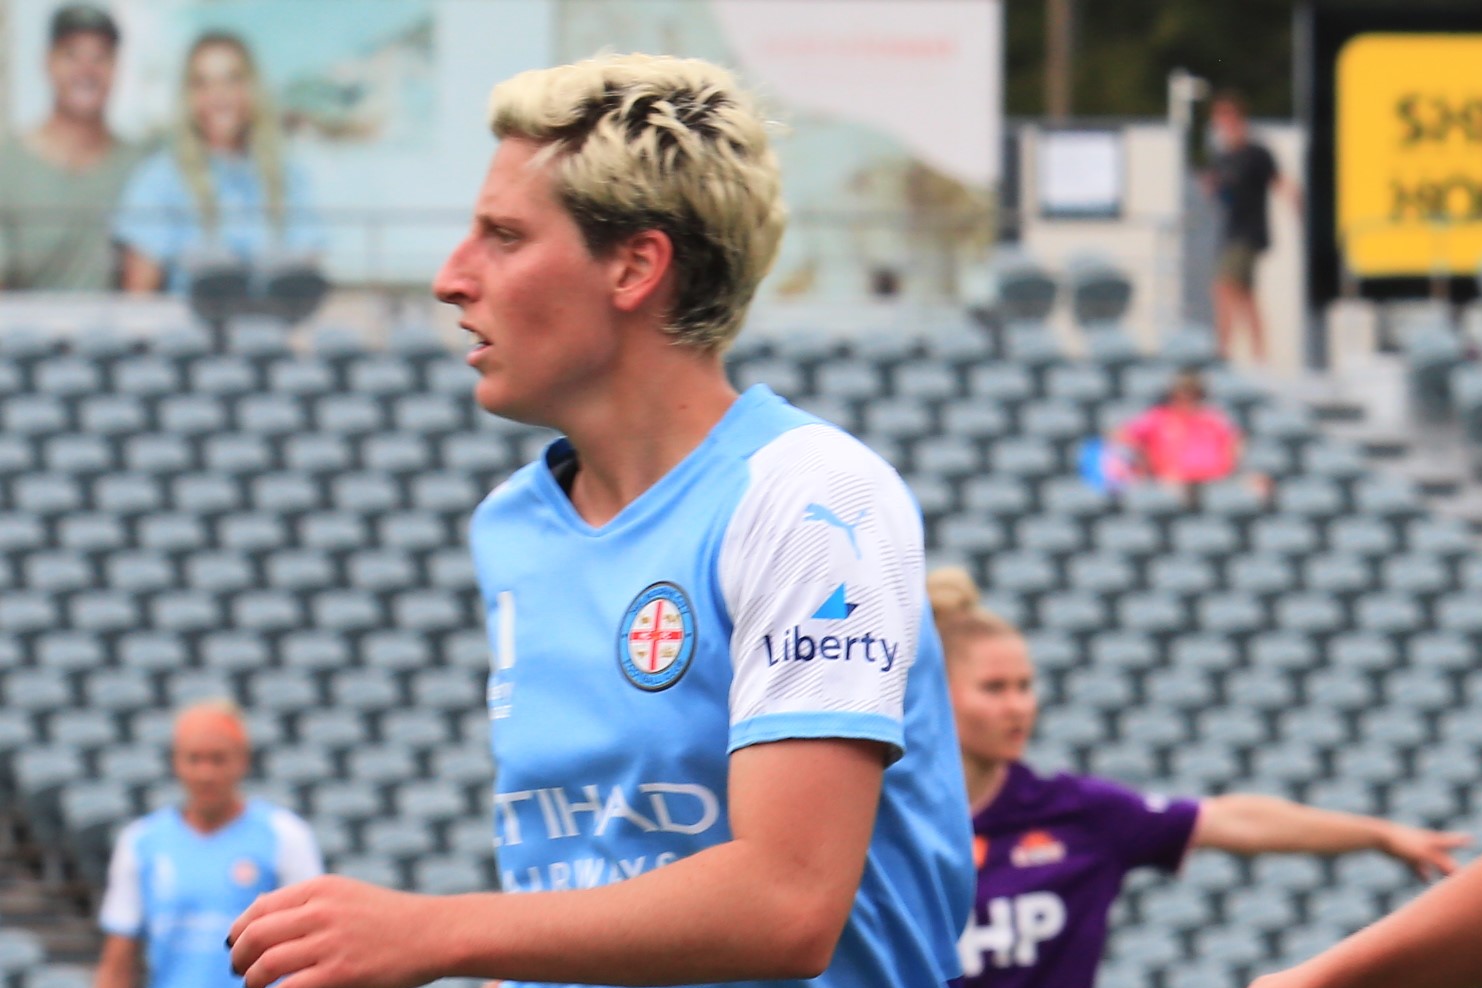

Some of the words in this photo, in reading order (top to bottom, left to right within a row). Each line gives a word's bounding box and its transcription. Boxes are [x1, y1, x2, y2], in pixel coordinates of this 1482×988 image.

[764, 624, 898, 672] Liberty
[493, 782, 720, 847] TIHAD
[957, 890, 1068, 978] HP
